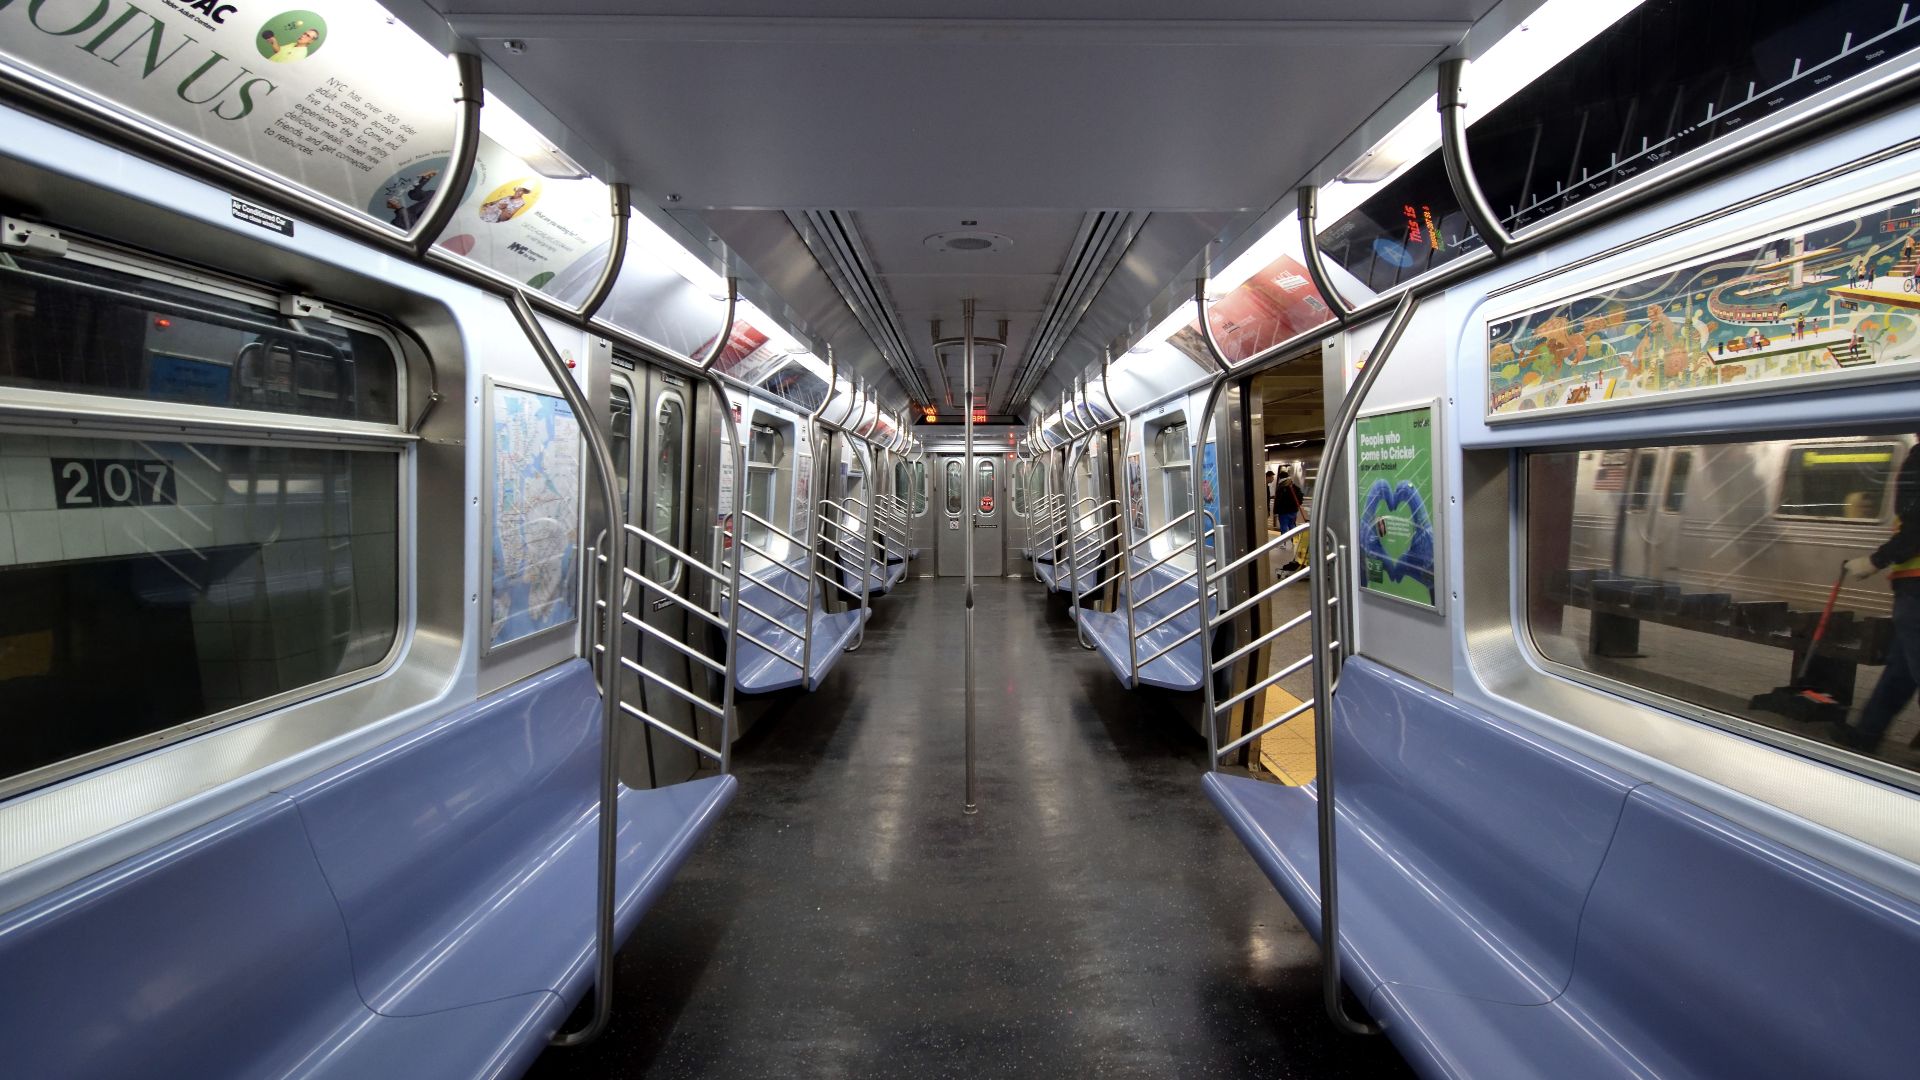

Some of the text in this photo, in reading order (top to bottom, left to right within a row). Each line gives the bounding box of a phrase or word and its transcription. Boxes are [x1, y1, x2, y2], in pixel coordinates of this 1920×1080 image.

[177, 8, 196, 20] Adult
[193, 16, 217, 32] Centers
[179, 0, 238, 24] AC
[0, 0, 279, 121] OIN US
[1865, 50, 1885, 61] Stops
[1814, 74, 1832, 85] Stops
[305, 93, 401, 150] five boroughs. Come and
[315, 86, 408, 144] adult centers across the
[326, 77, 419, 136] NYC has over 300 older
[263, 127, 313, 156] to resources.
[273, 118, 374, 173] friends, and get connected
[284, 111, 320, 133] delicious
[346, 144, 366, 157] meet
[364, 154, 381, 164] new
[294, 103, 391, 159] experience the fun, enjoy
[1647, 153, 1659, 163] 10
[232, 201, 287, 226] Air Conditioned Car
[1403, 204, 1422, 243] This is
[1360, 430, 1401, 448] People who
[1360, 445, 1415, 461] come to Cricket
[62, 462, 168, 504] 207
